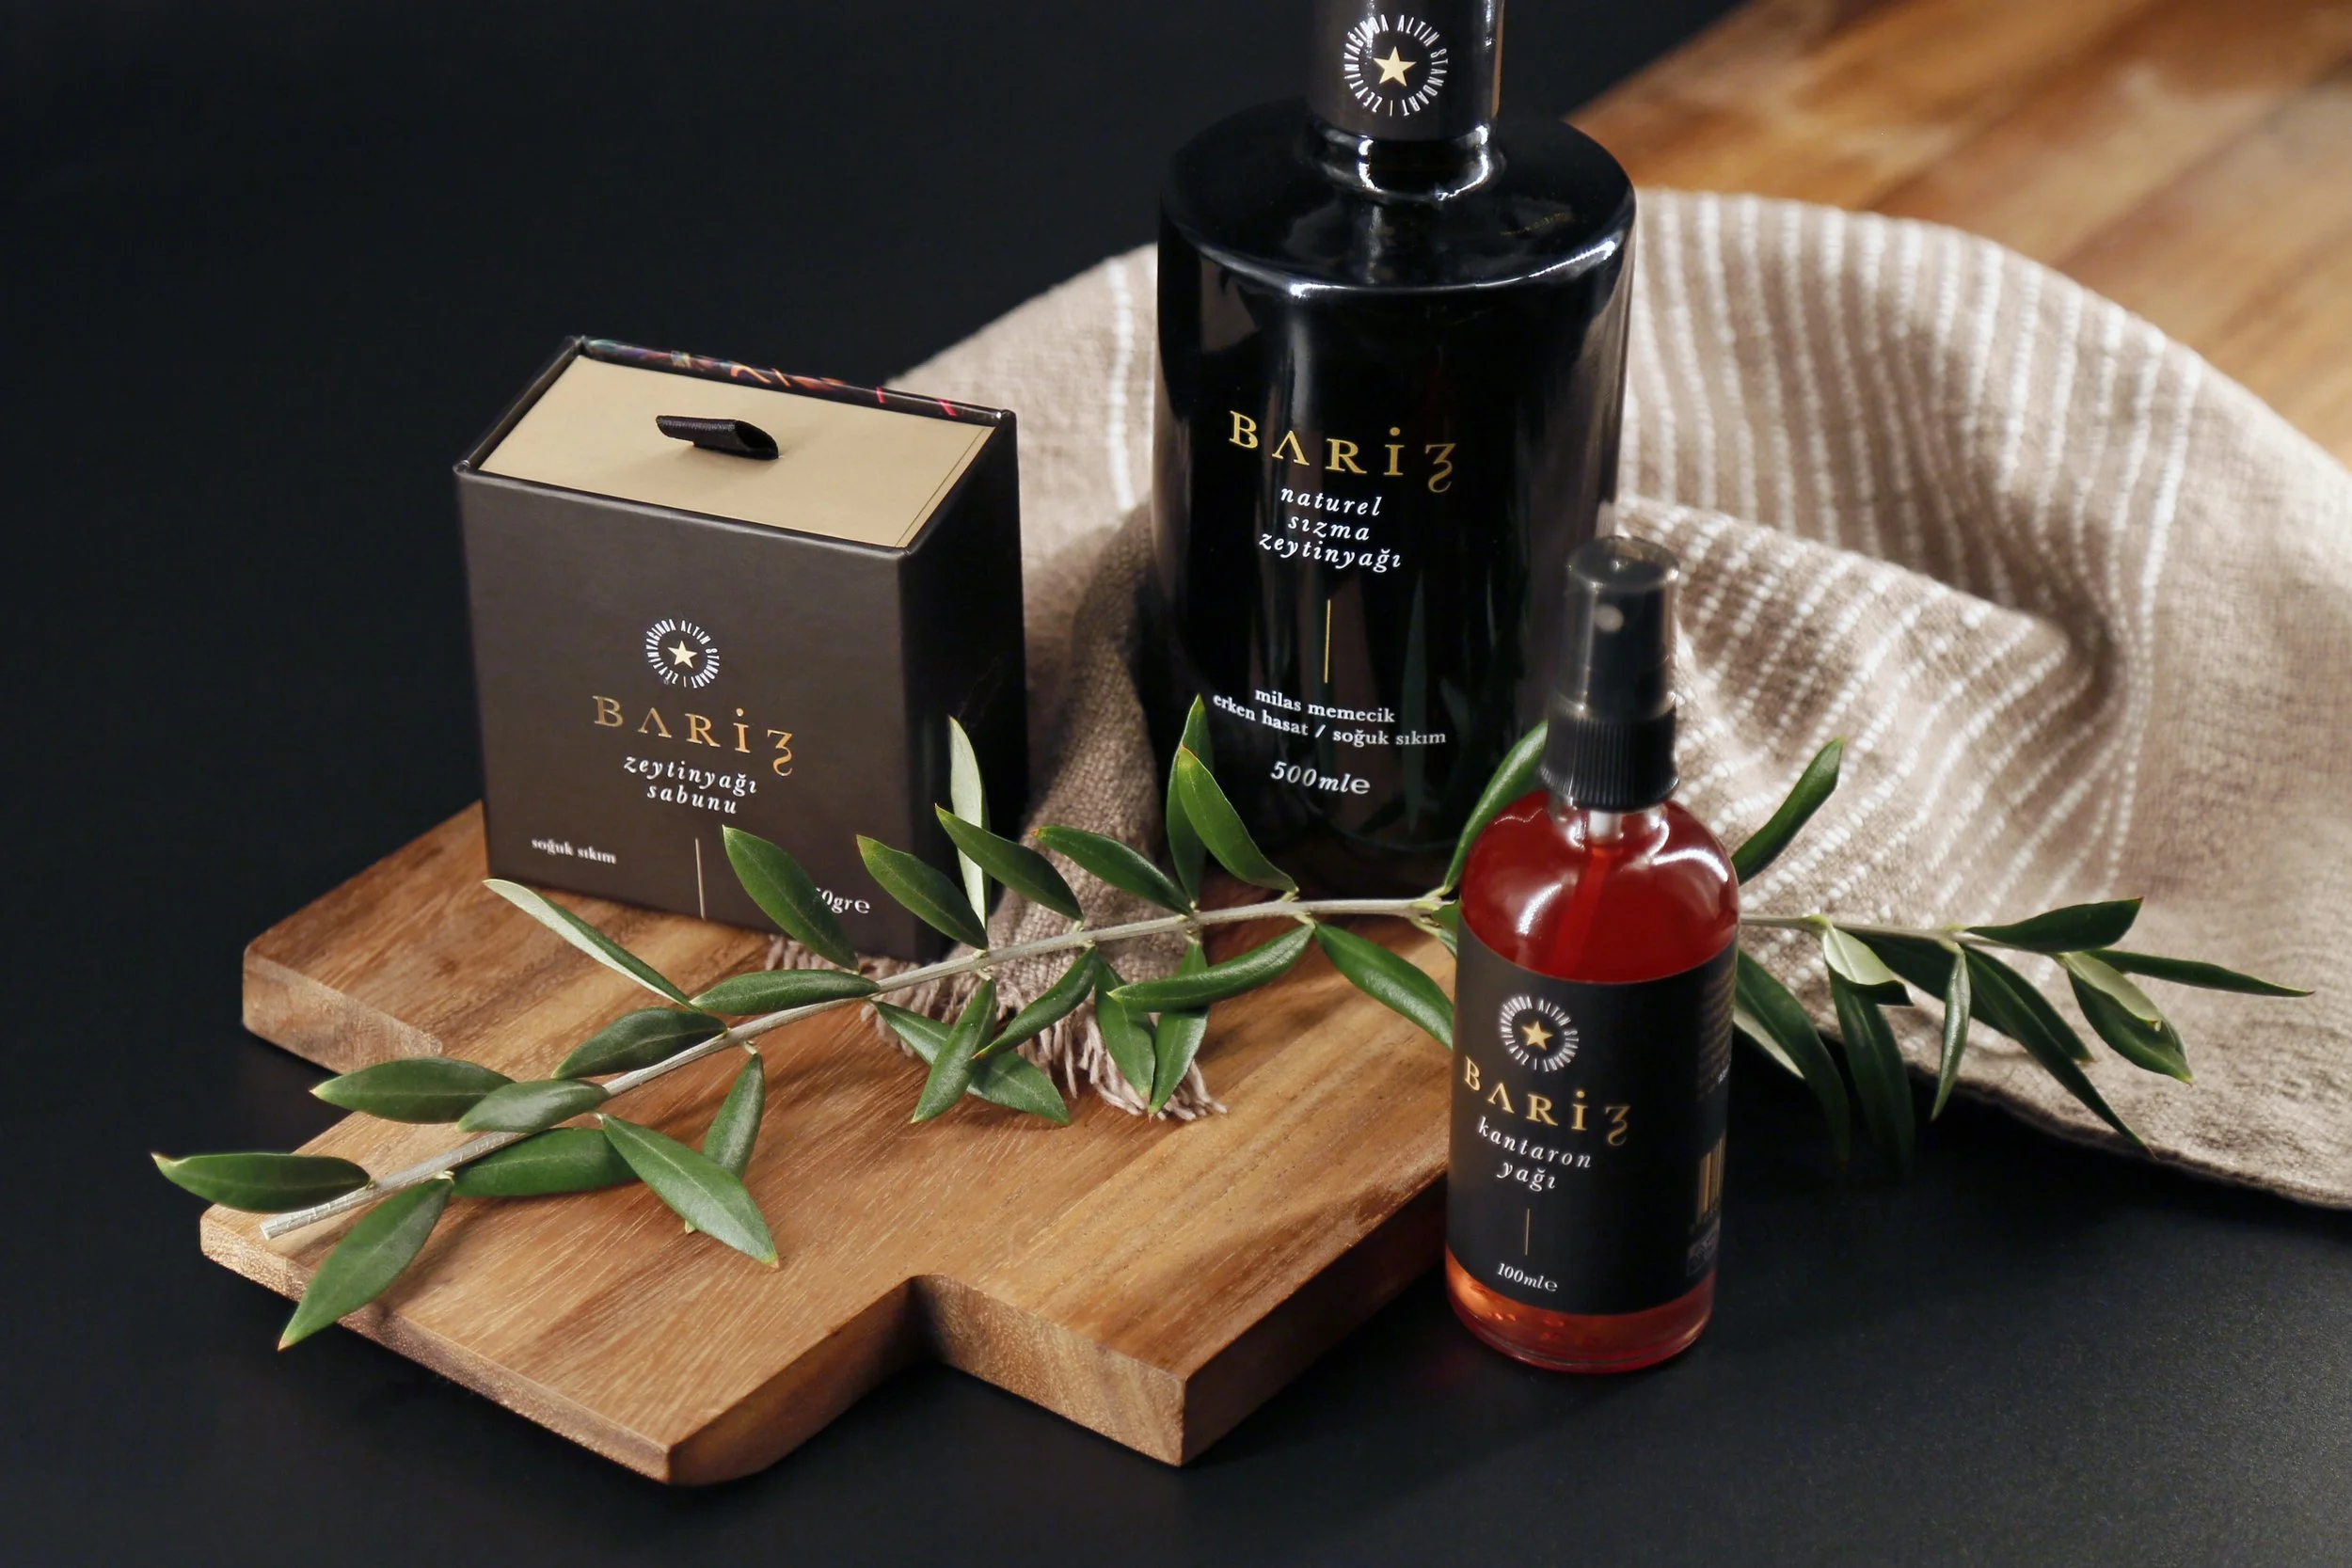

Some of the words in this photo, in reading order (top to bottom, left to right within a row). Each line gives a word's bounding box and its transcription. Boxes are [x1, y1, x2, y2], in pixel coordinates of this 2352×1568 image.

[1397, 14, 1440, 47] ALTIN
[1401, 48, 1449, 117] STANDART
[1279, 486, 1383, 516] naturel
[1288, 515, 1371, 542] sızma
[1258, 532, 1402, 573] zeytinyağı
[1212, 693, 1256, 721] erken
[1261, 709, 1309, 736] hasat
[1332, 728, 1390, 749] soğuk
[1395, 730, 1446, 746] sıkım
[1254, 689, 1302, 712] milas
[1308, 704, 1395, 723] memecik
[623, 755, 758, 798] zeytinyağı
[646, 784, 738, 816] sabunu
[531, 836, 573, 858] soğuk
[578, 846, 617, 865] sıkım
[1477, 1116, 1593, 1169] kantaron
[1496, 1161, 1557, 1193] yağı
